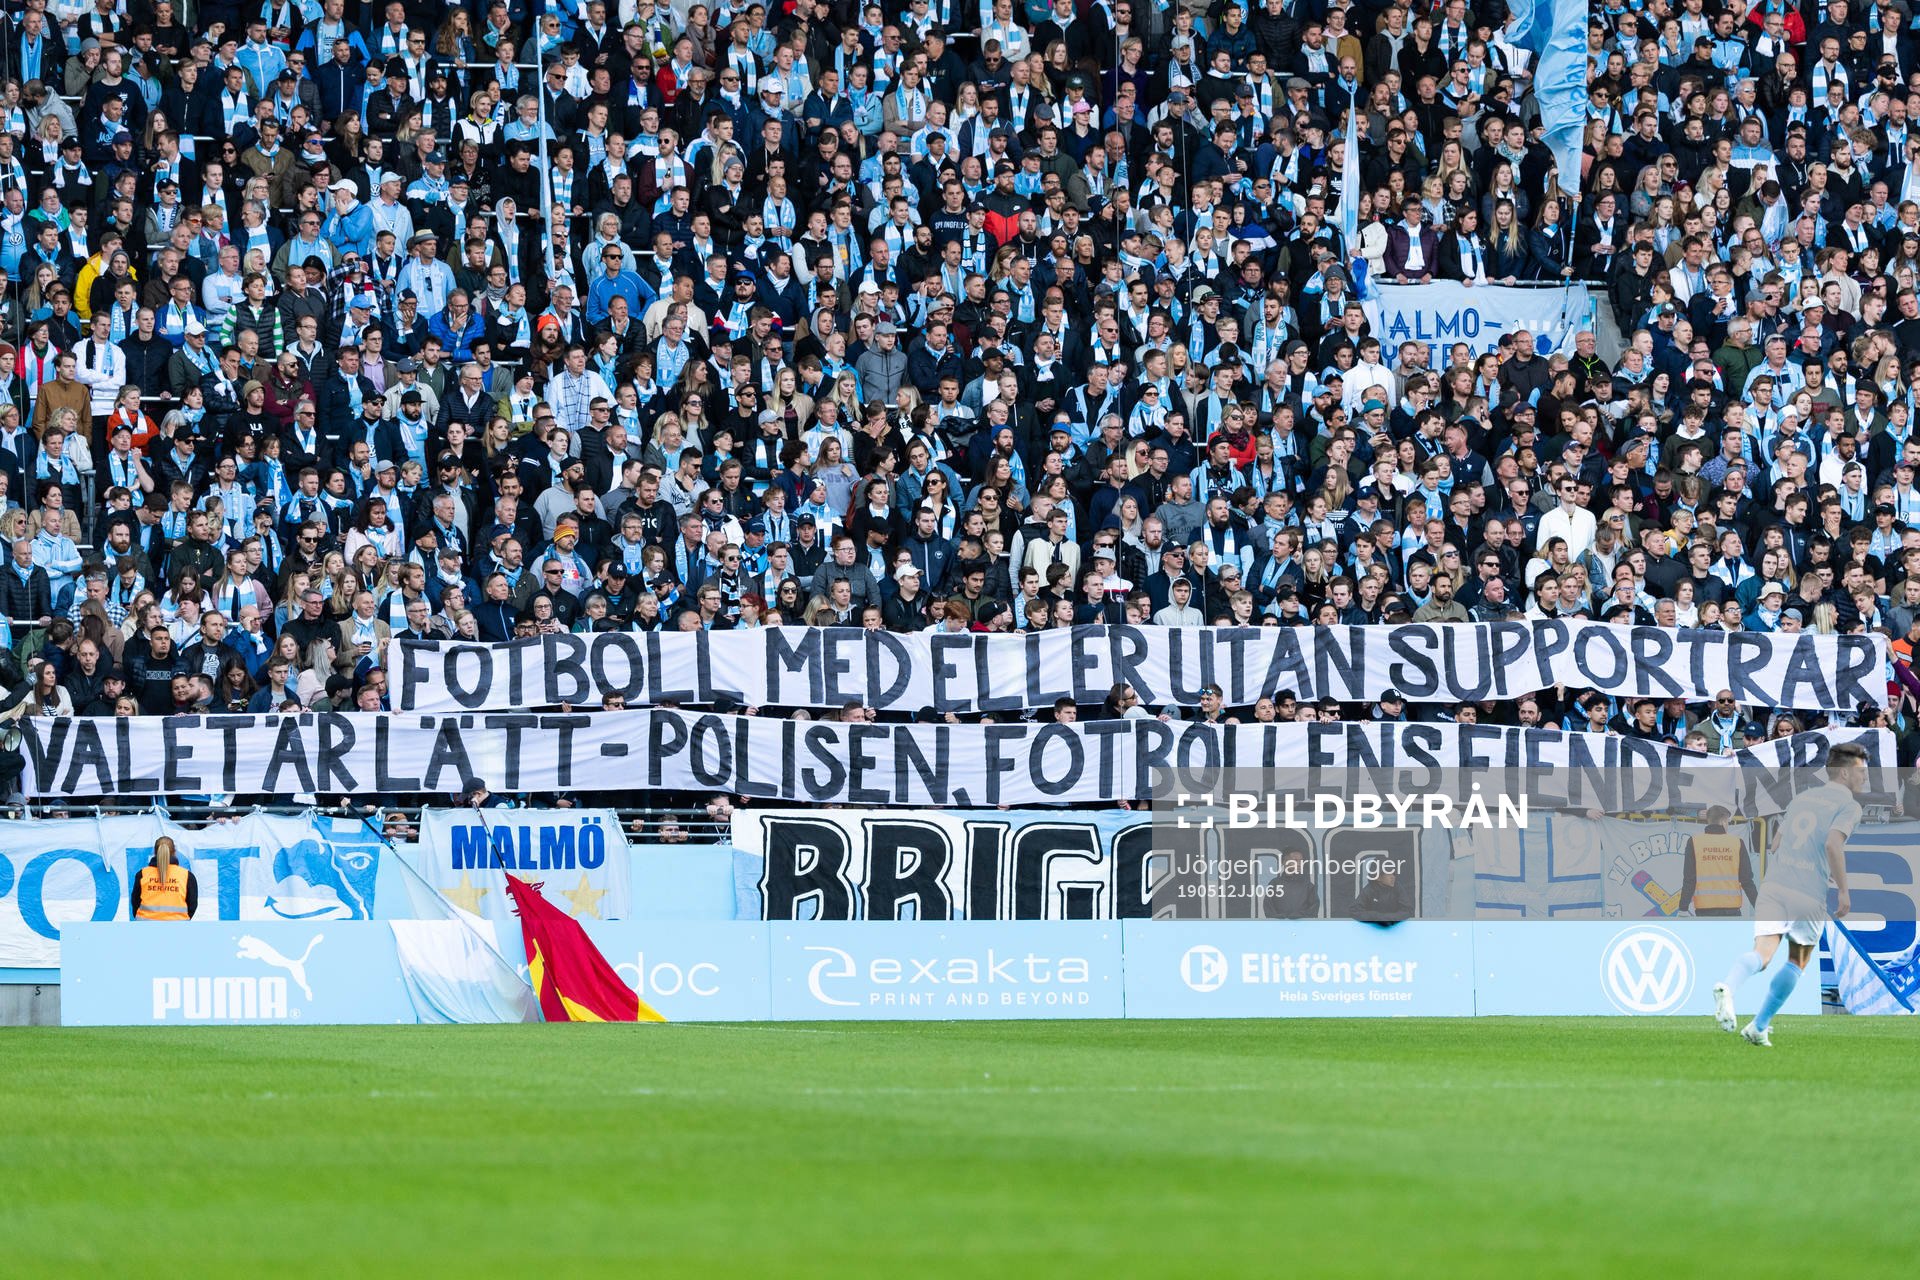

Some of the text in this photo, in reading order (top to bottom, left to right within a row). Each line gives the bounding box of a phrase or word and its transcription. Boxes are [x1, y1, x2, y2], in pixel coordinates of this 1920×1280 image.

[400, 619, 1878, 712] FOTBOLL MED ELLER UTAN SUPPORTRAR
[985, 719, 1443, 800] FOTBOLLENS
[1458, 724, 1709, 812] FIENDE
[451, 816, 606, 870] MALMÖ
[869, 947, 1090, 984] exakta
[1241, 953, 1418, 984] Elitfönster
[153, 976, 287, 1019] PUMA
[869, 991, 1090, 1006] PRINT AND BEYOND
[1280, 990, 1413, 1004] Hela Sveriges fönster
